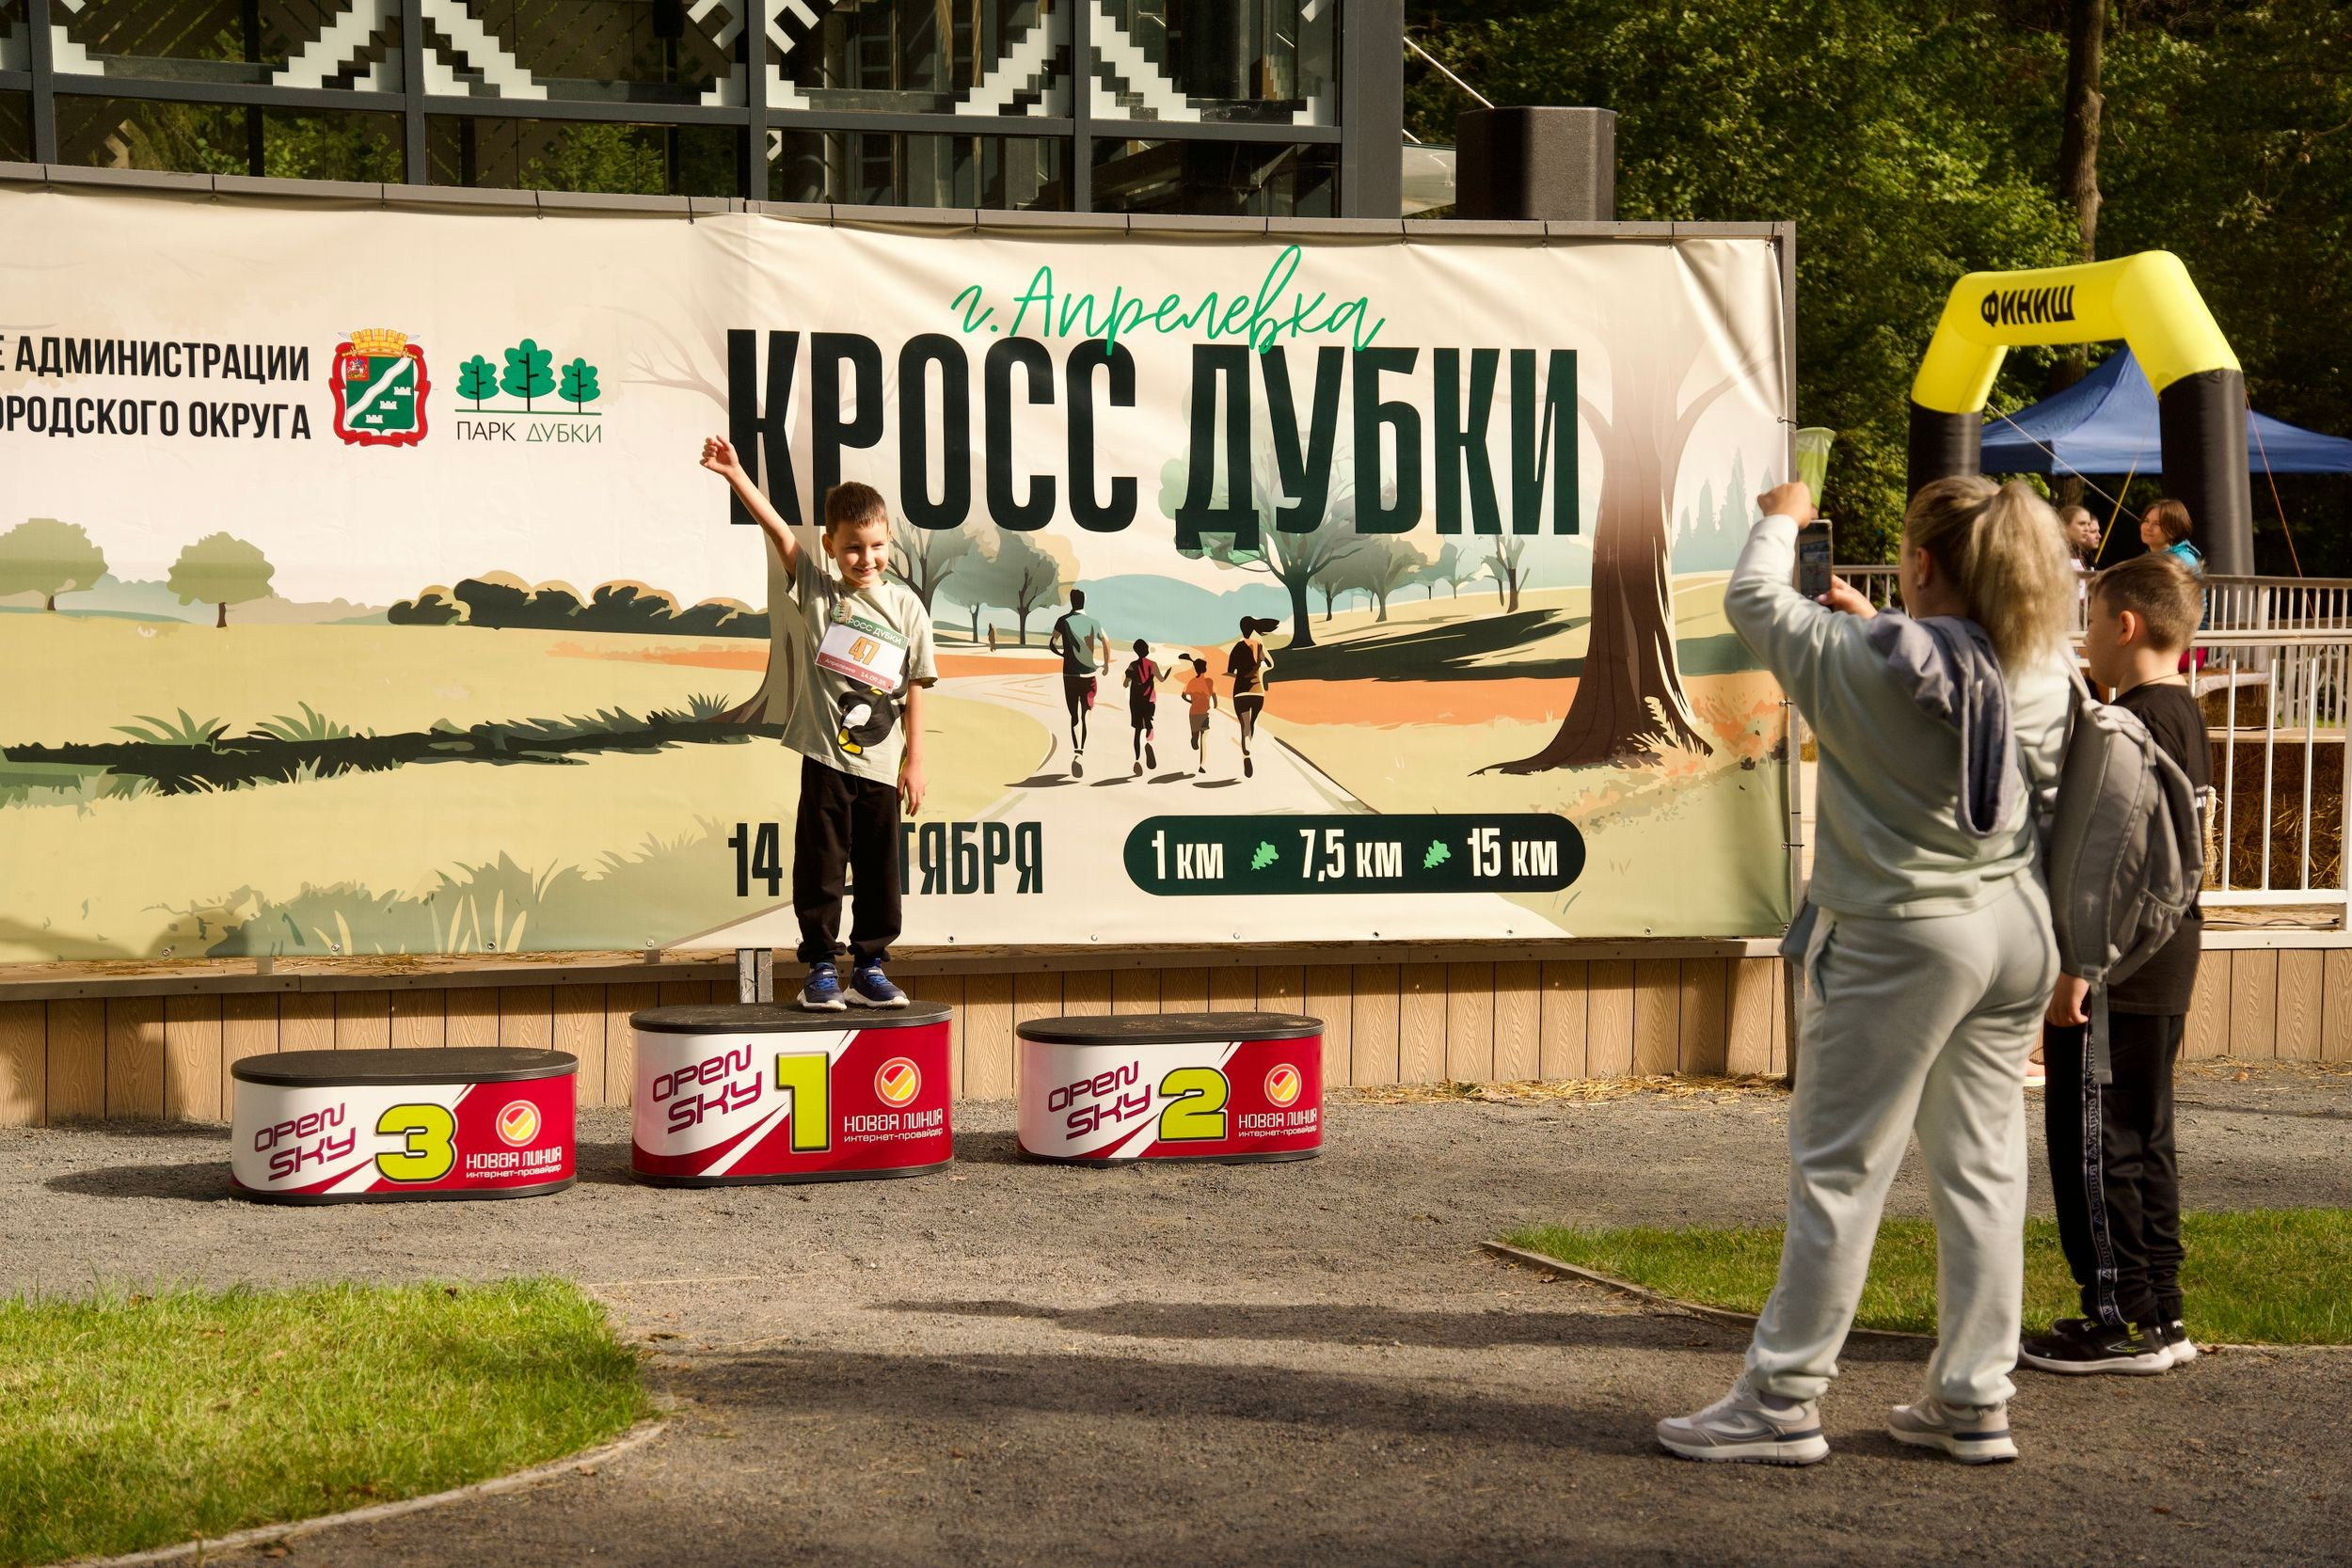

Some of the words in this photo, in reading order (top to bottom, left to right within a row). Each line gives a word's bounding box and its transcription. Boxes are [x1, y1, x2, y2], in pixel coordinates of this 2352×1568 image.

[1981, 285, 2075, 327] ФИНИШ
[15, 335, 310, 385] АДМИНИСТРАЦИИ
[0, 395, 179, 437] РОДСКОГО
[189, 401, 311, 439] ОКРУГА
[456, 420, 516, 441] ПАРК
[727, 329, 1137, 532] КРОСС
[1175, 343, 1581, 550] ДУБКИ
[845, 618, 873, 632] РОСС
[873, 627, 902, 644] ДУБКИ
[848, 636, 881, 665] 47
[728, 822, 783, 896] 14
[843, 821, 1042, 895] ТЯБРЯ
[1152, 830, 1166, 879] 1
[1299, 829, 1345, 882] 7,5
[1468, 828, 1502, 878] 15
[775, 1051, 832, 1152] 1
[1157, 1067, 1231, 1143] 2
[2088, 1098, 2099, 1145] Kappa
[373, 1102, 458, 1183] 3
[843, 1127, 944, 1143] интернет-провайдер
[1238, 1125, 1317, 1138] интернет-провайдер
[466, 1164, 563, 1179] интернет-провайдер
[2088, 1164, 2103, 1211] Kappa
